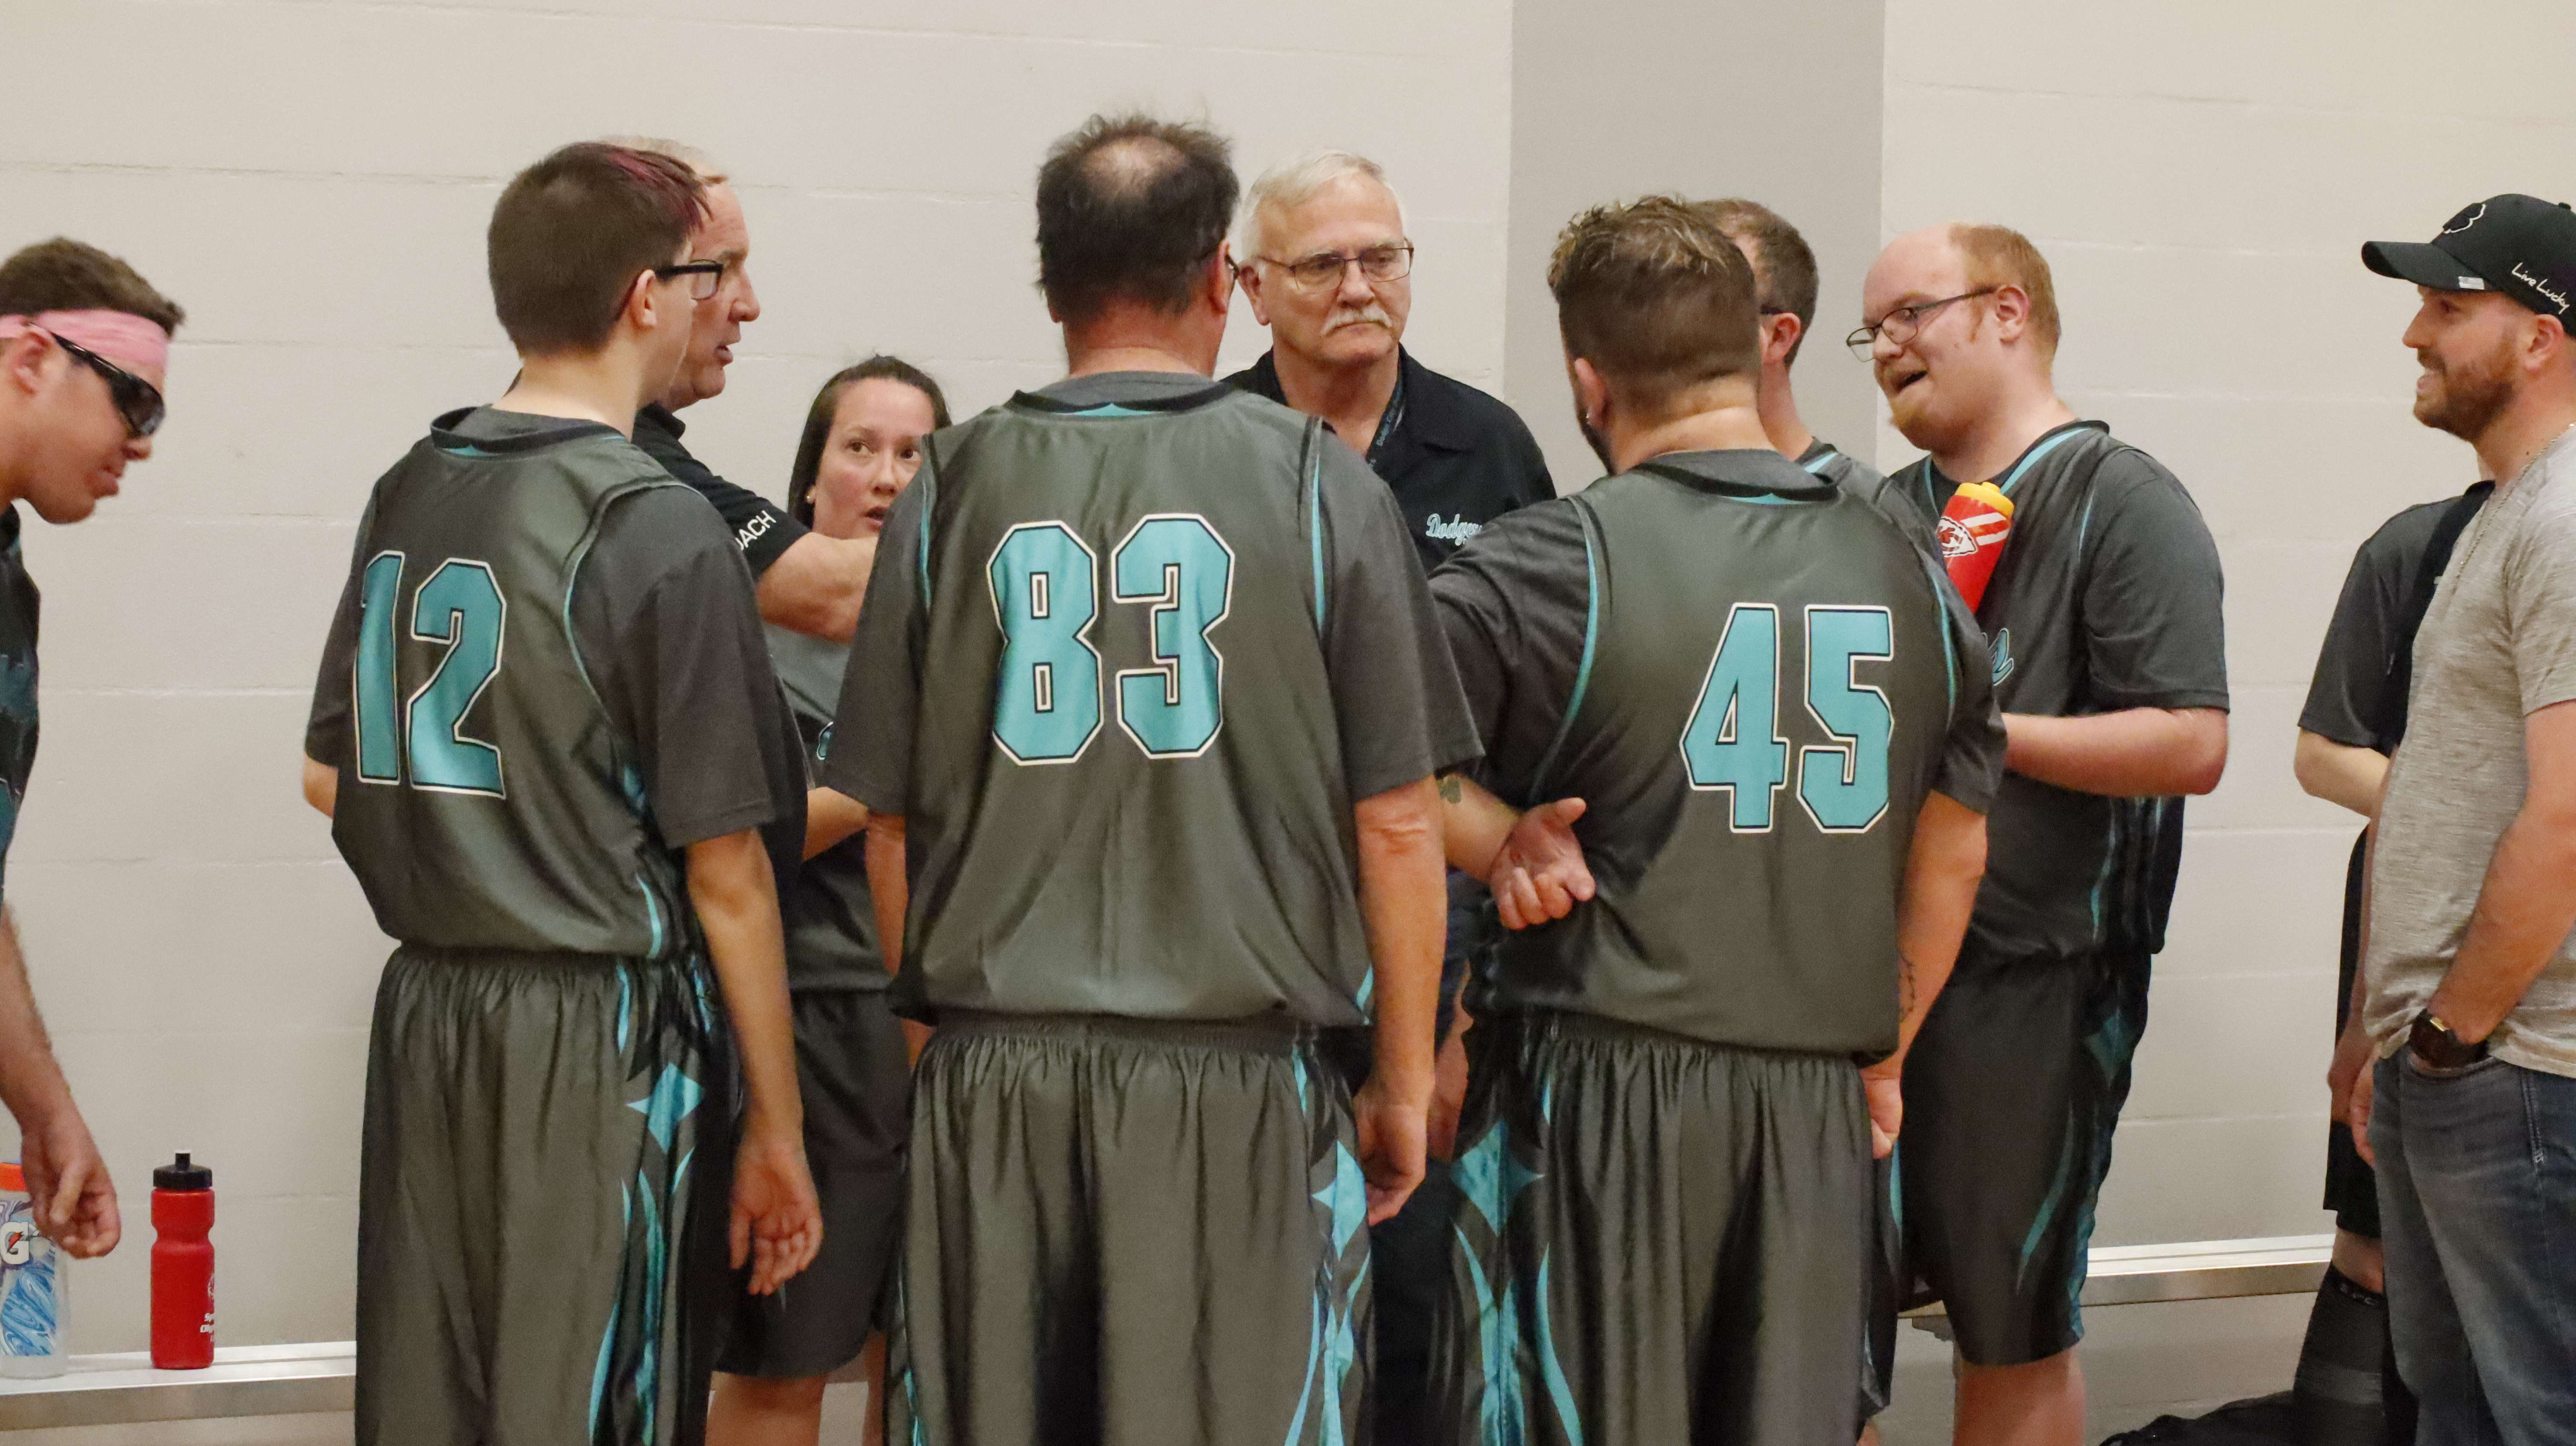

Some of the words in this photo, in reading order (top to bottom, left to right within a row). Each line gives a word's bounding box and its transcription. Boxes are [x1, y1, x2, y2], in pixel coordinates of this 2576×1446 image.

[2512, 262, 2537, 287] Live
[2536, 279, 2570, 315] Lucky
[353, 550, 507, 799] 12
[986, 513, 1235, 766] 83
[1679, 602, 1894, 833] 45
[0, 1221, 29, 1264] G
